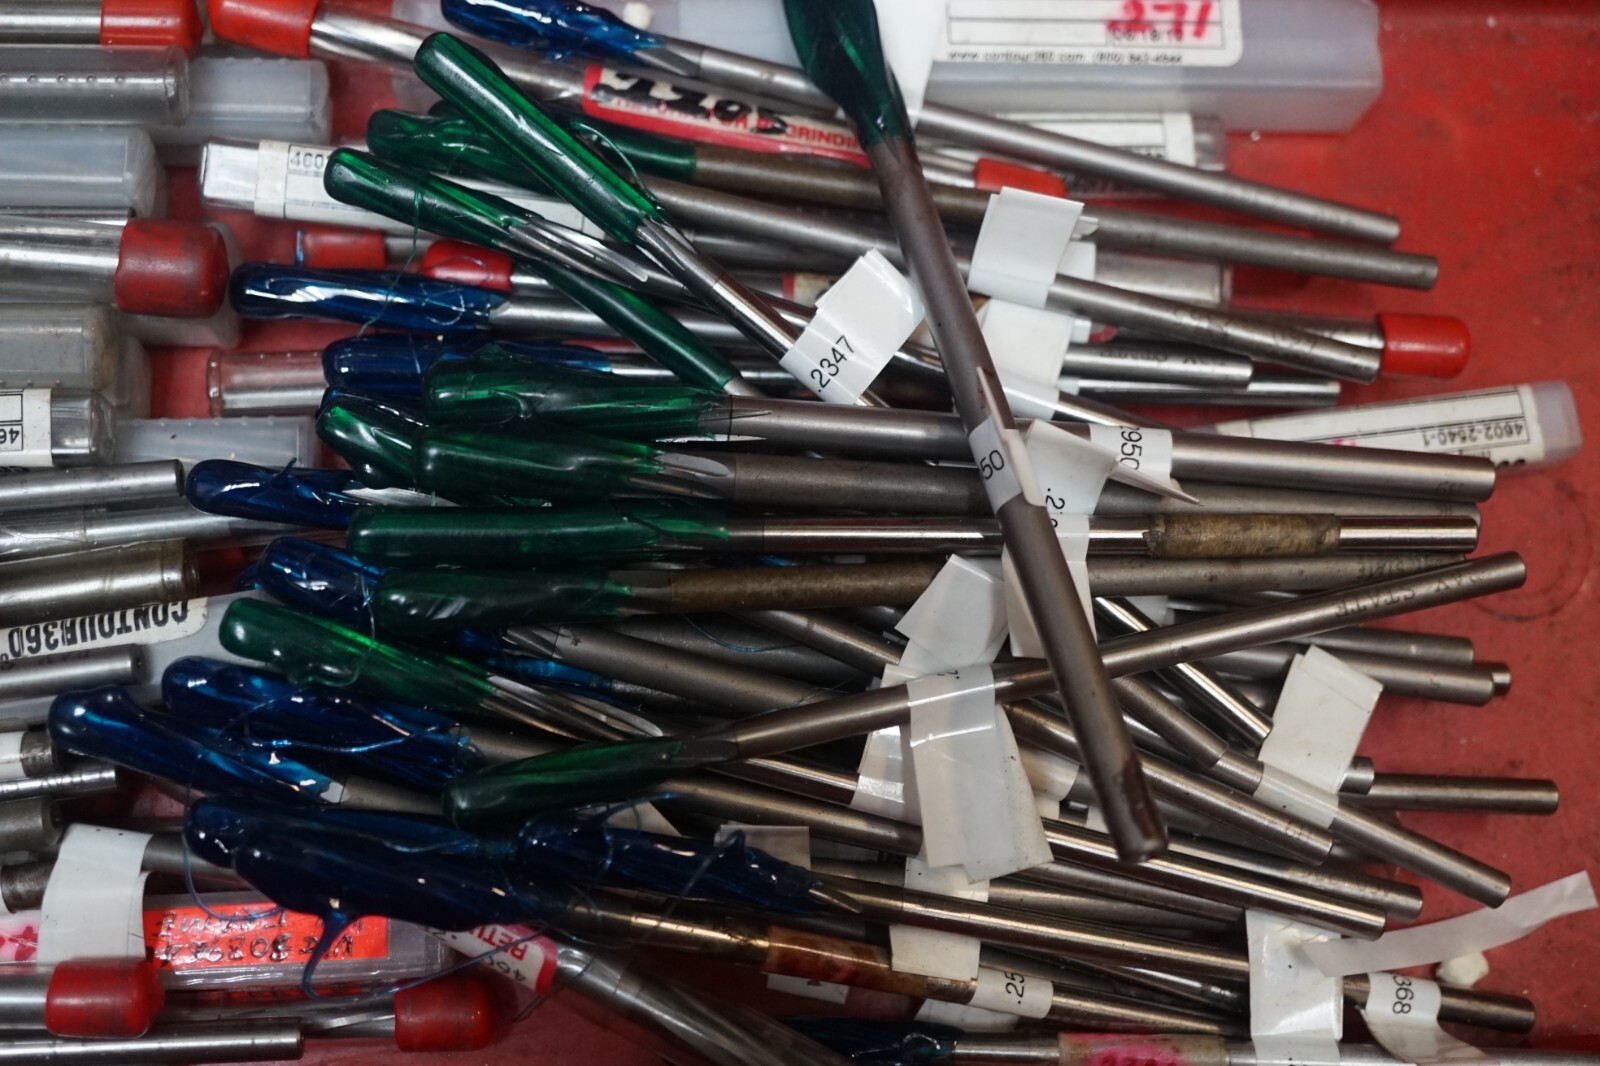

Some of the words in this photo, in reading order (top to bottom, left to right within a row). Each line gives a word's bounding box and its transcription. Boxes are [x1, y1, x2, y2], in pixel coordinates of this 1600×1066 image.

[290, 151, 330, 170] 460
[810, 335, 855, 393] .2347
[1119, 426, 1143, 470] 950
